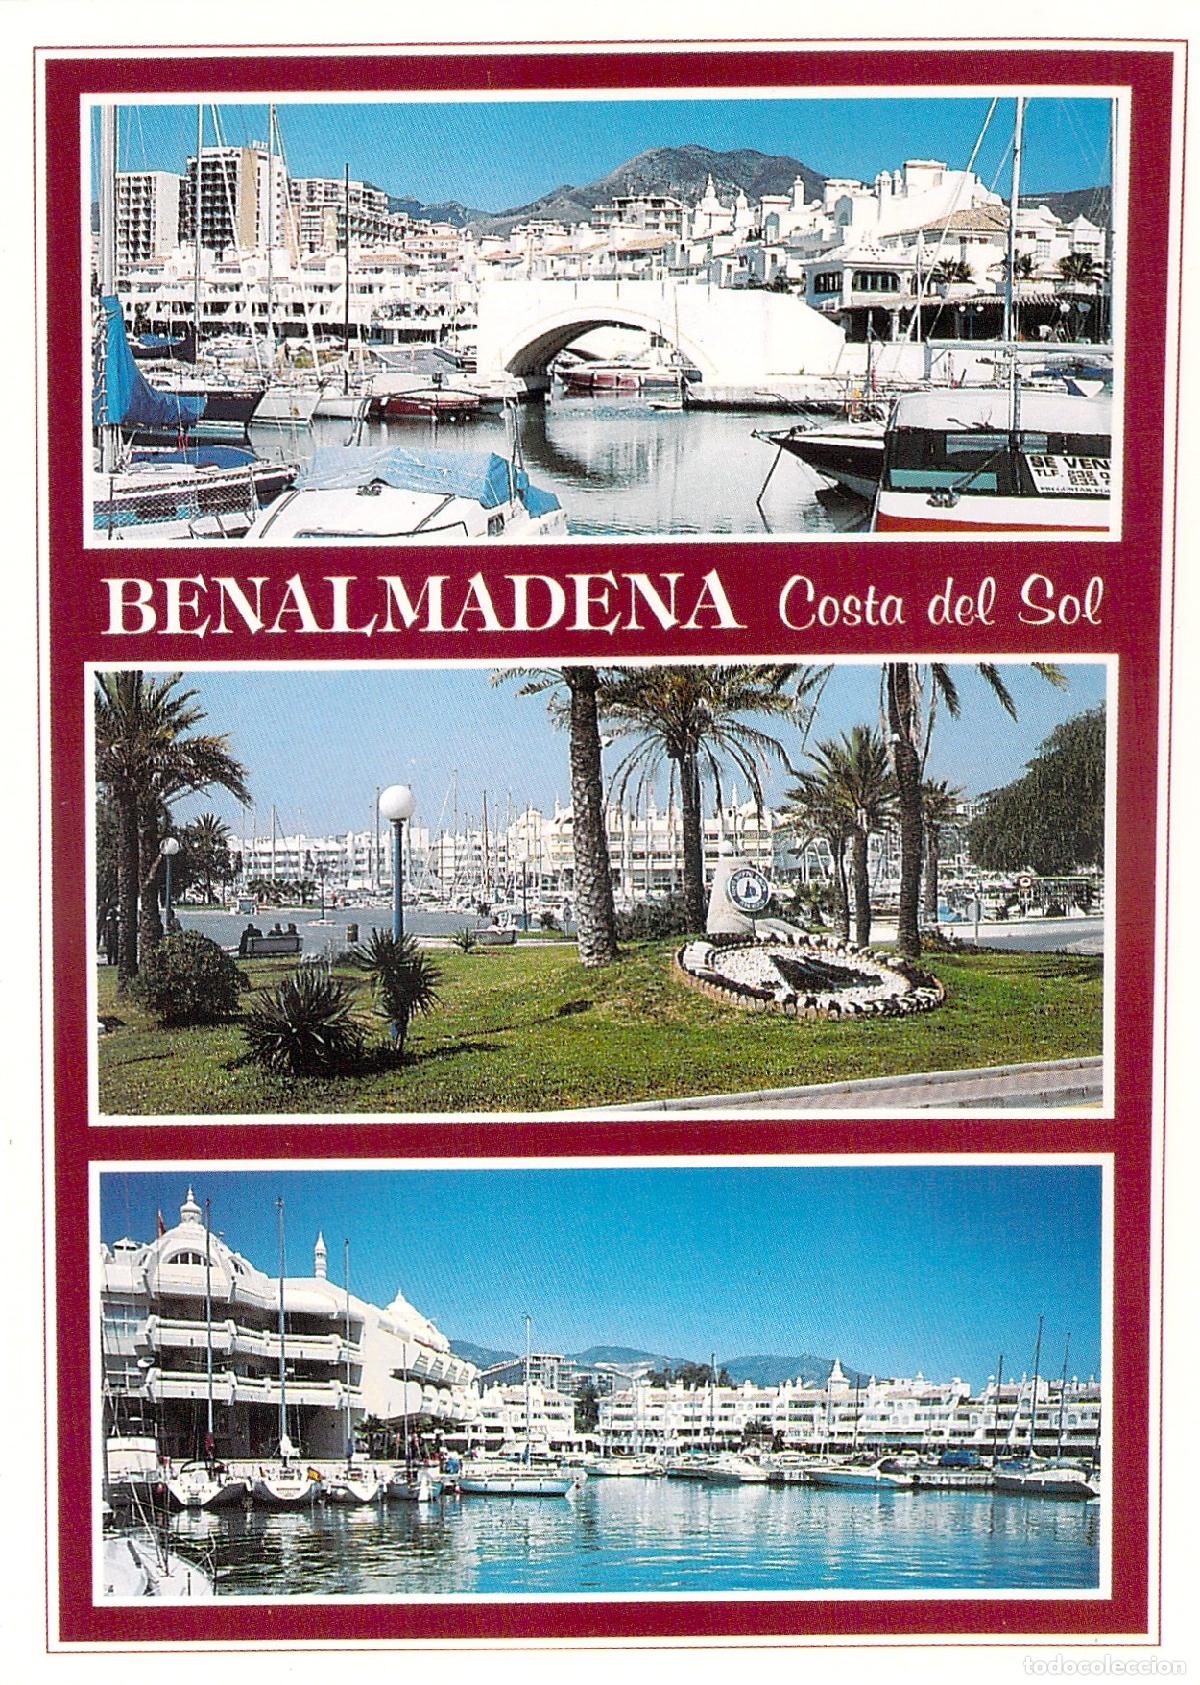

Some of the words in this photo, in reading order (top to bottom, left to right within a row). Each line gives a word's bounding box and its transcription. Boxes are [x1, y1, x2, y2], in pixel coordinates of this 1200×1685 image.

[1029, 455, 1057, 468] SE
[100, 568, 748, 638] BENALMADENA
[778, 574, 906, 631] Costa
[927, 576, 996, 626] del
[1018, 573, 1104, 625] Sol
